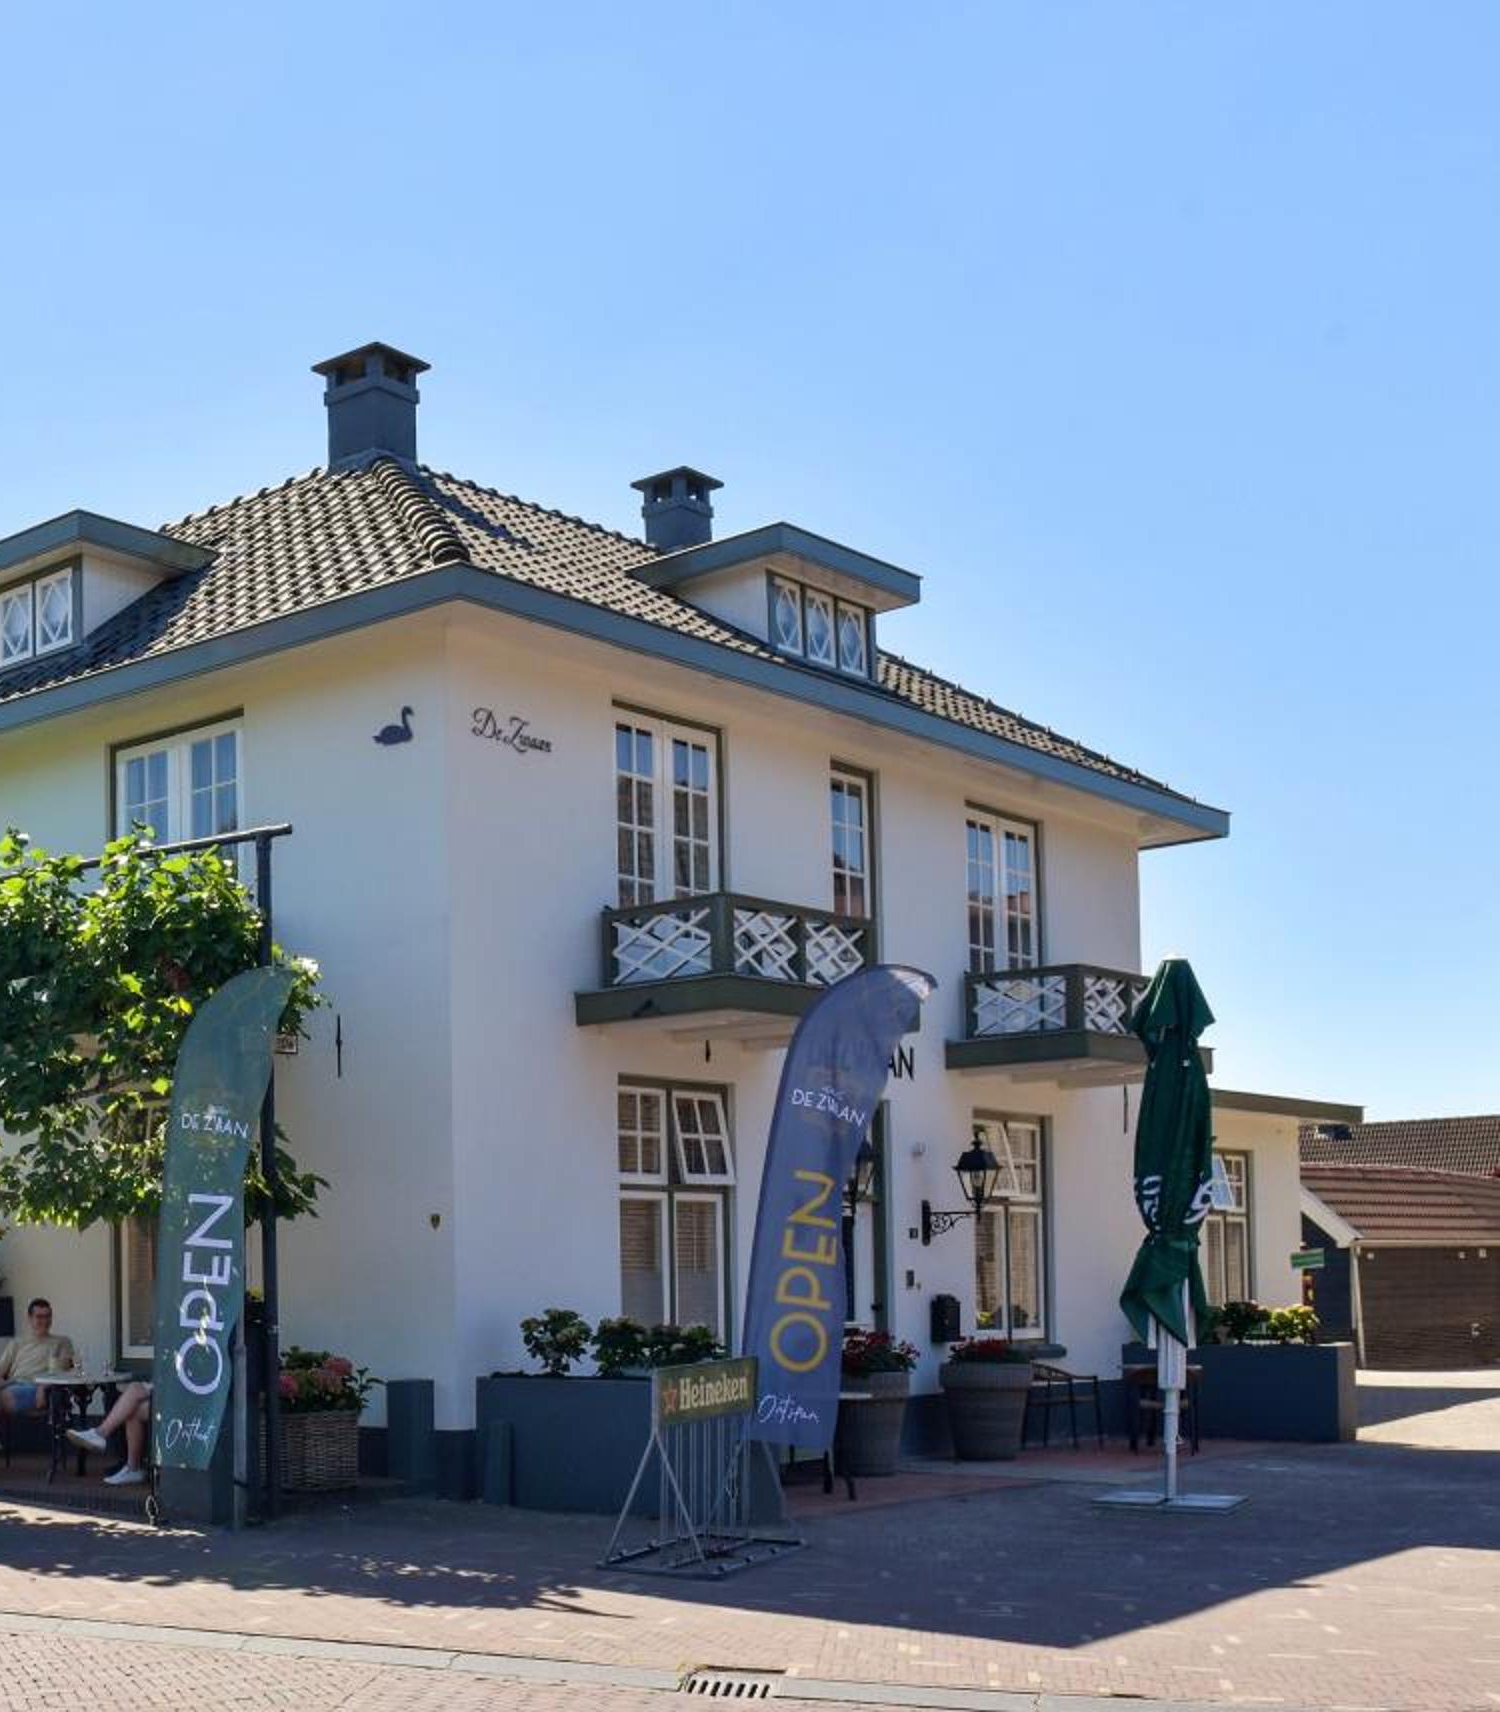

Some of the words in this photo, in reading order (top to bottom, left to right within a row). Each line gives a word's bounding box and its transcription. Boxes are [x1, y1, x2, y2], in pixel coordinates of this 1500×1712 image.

[471, 707, 502, 741] De
[791, 1088, 815, 1107] DE
[770, 1169, 837, 1373] OPEN
[174, 1193, 234, 1395] OPEN
[678, 1374, 749, 1410] Heineken
